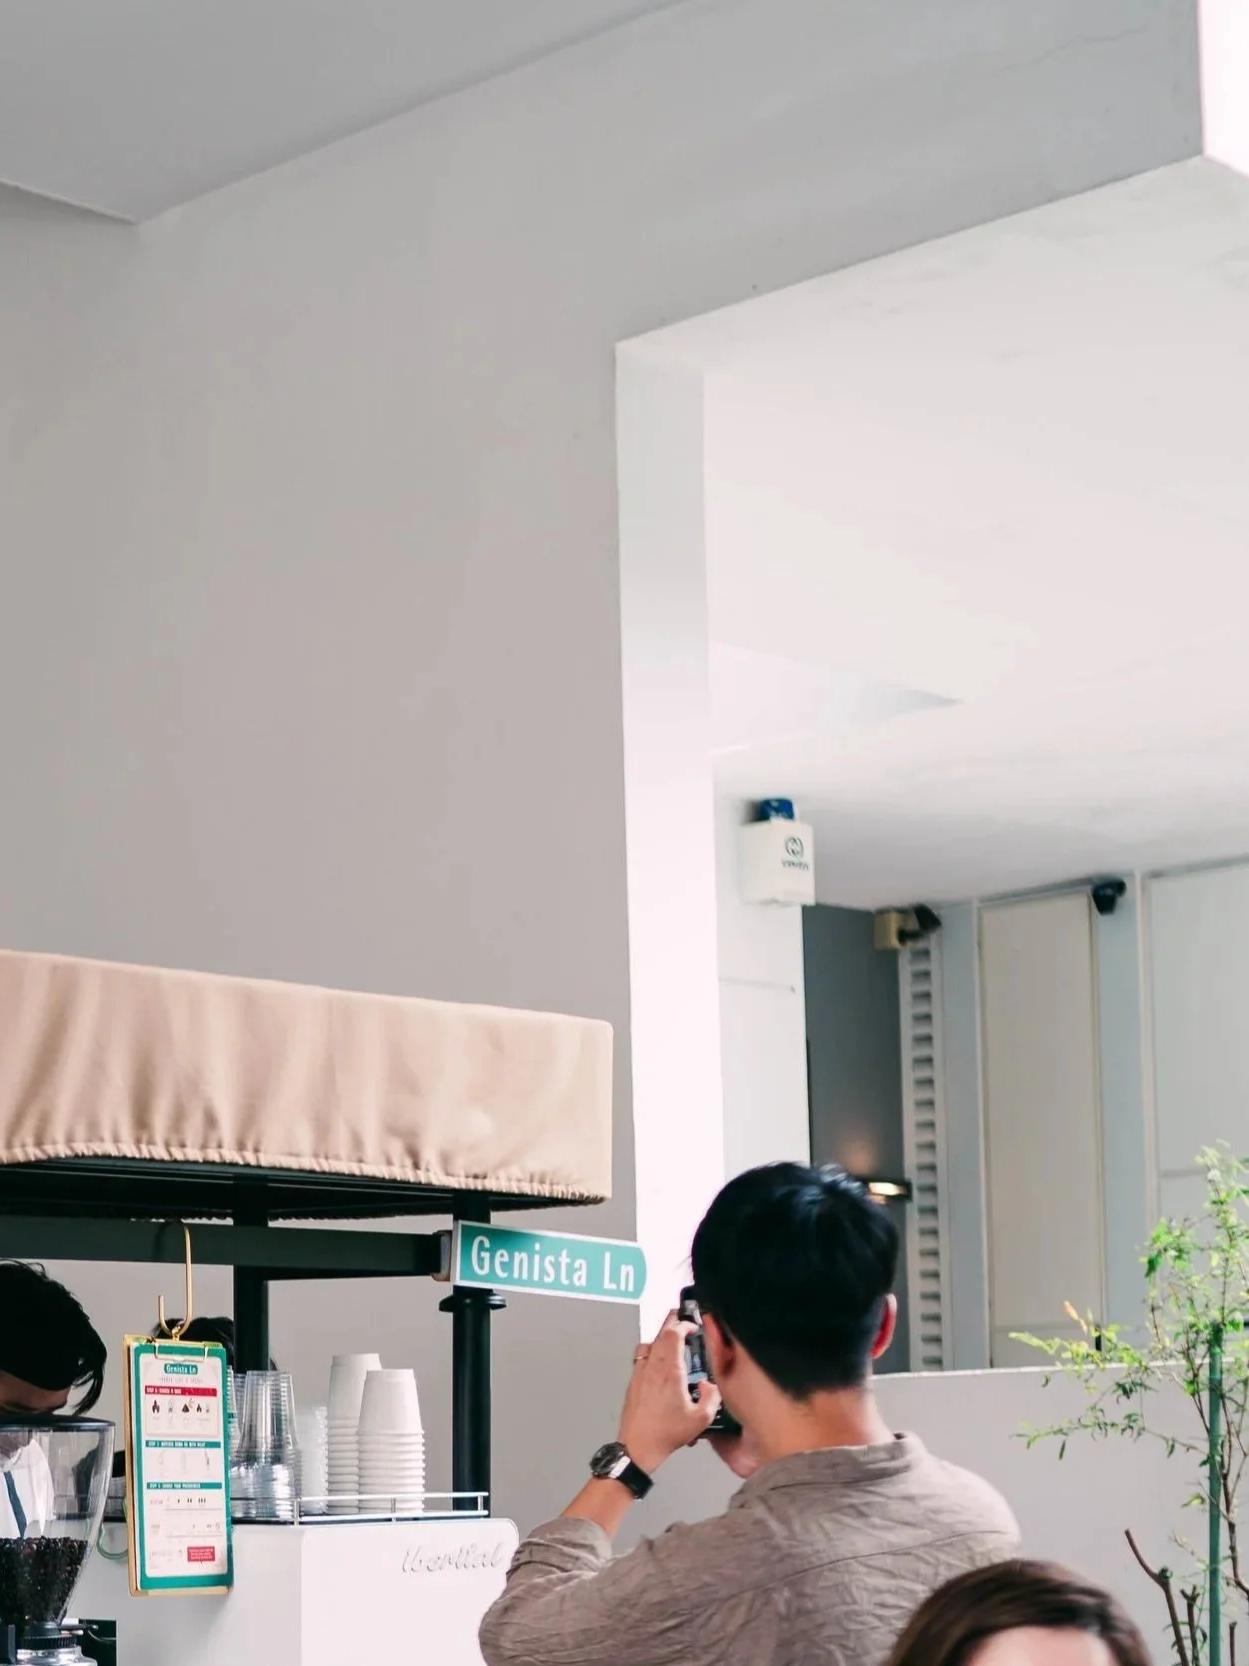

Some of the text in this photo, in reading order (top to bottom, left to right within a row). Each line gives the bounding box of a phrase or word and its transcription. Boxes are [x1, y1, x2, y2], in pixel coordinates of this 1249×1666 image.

[471, 1235, 635, 1292] Genista Ln
[166, 1364, 187, 1373] Genista
